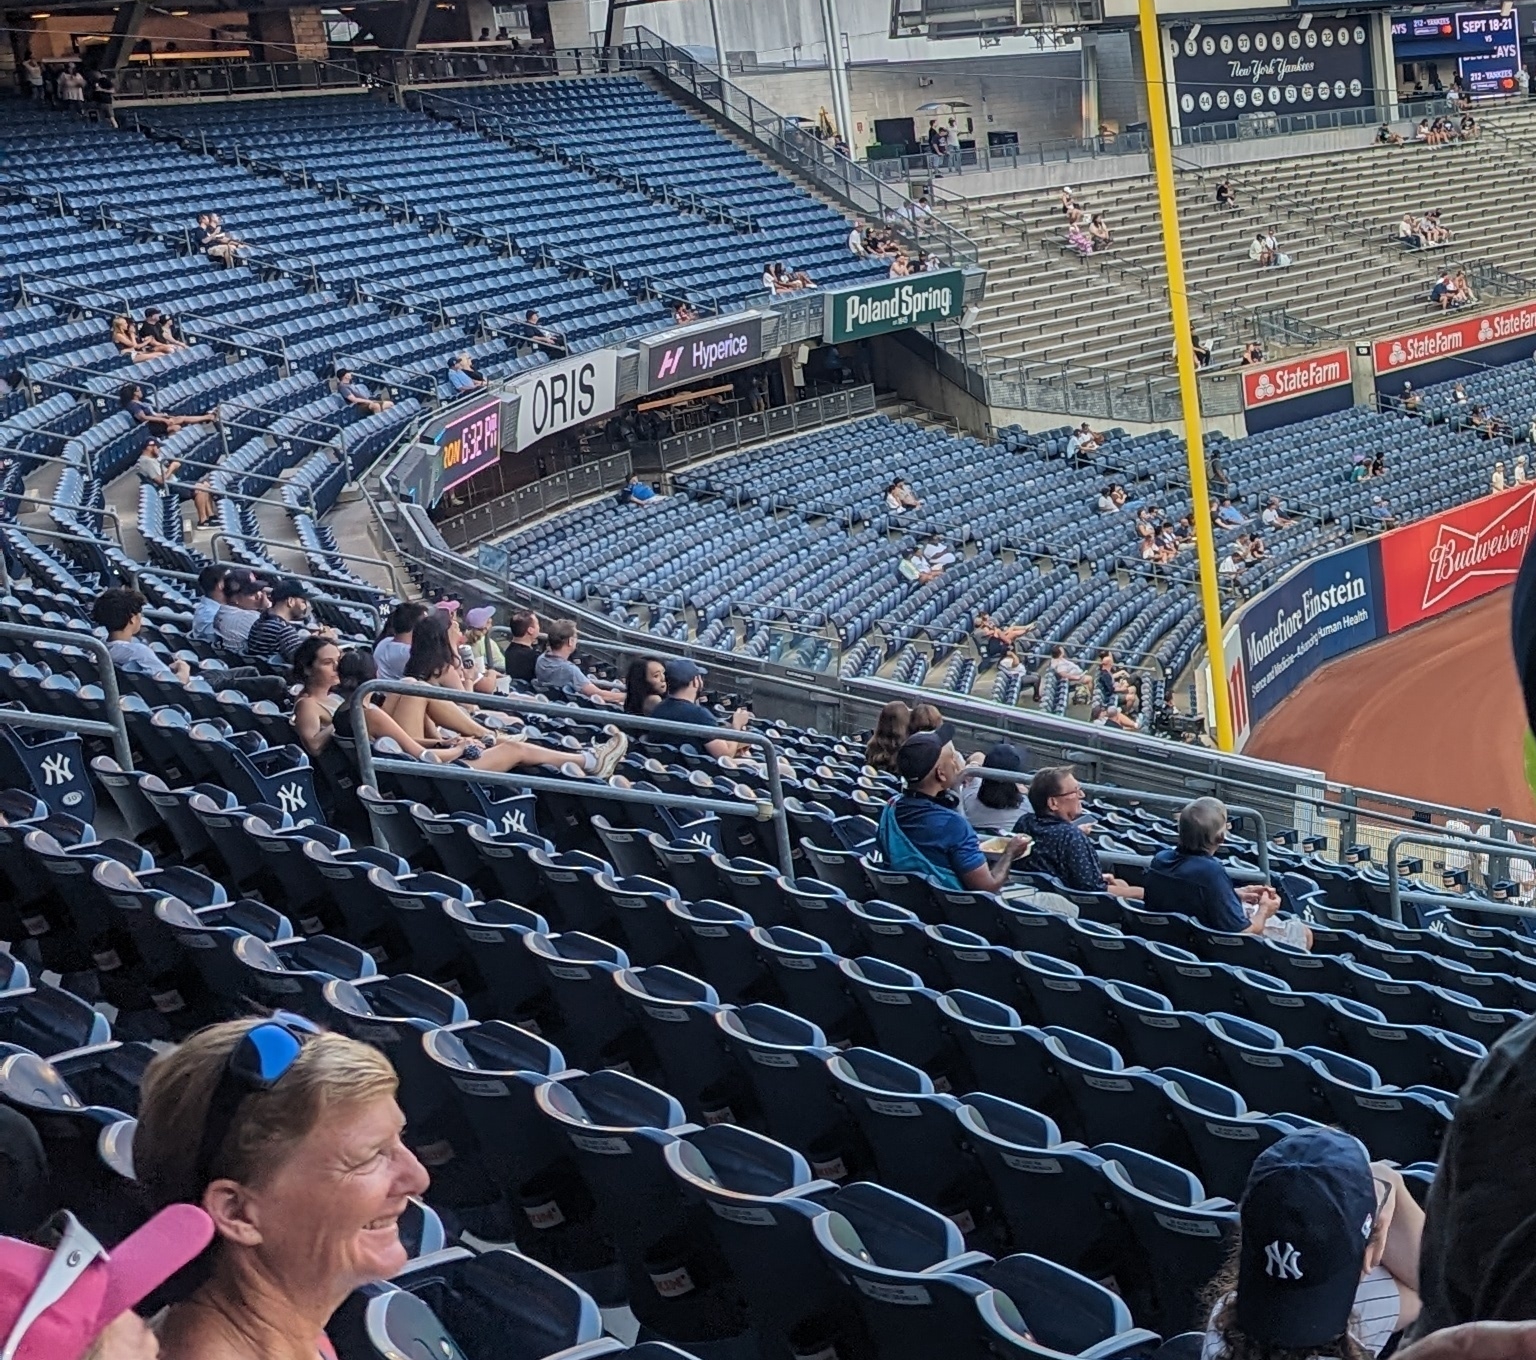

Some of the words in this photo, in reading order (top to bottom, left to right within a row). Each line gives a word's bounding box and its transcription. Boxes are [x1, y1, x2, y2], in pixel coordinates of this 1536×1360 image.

[1391, 24, 1407, 35] AYS
[1463, 20, 1486, 33] SEPT
[1489, 18, 1512, 30] 18-21
[1251, 59, 1275, 83] York
[1277, 56, 1315, 81] Yankees
[1494, 45, 1516, 58] AYS
[845, 287, 899, 333] Poland
[901, 283, 951, 322] Spring
[692, 332, 748, 371] Hyperice
[532, 362, 595, 435] ORIS
[462, 420, 483, 465] 6:32
[1429, 512, 1530, 584] Budweiser
[1247, 609, 1303, 671] Montefiore
[1301, 571, 1366, 625] Einstein
[1343, 608, 1368, 628] Health
[1264, 1240, 1304, 1280] NY
